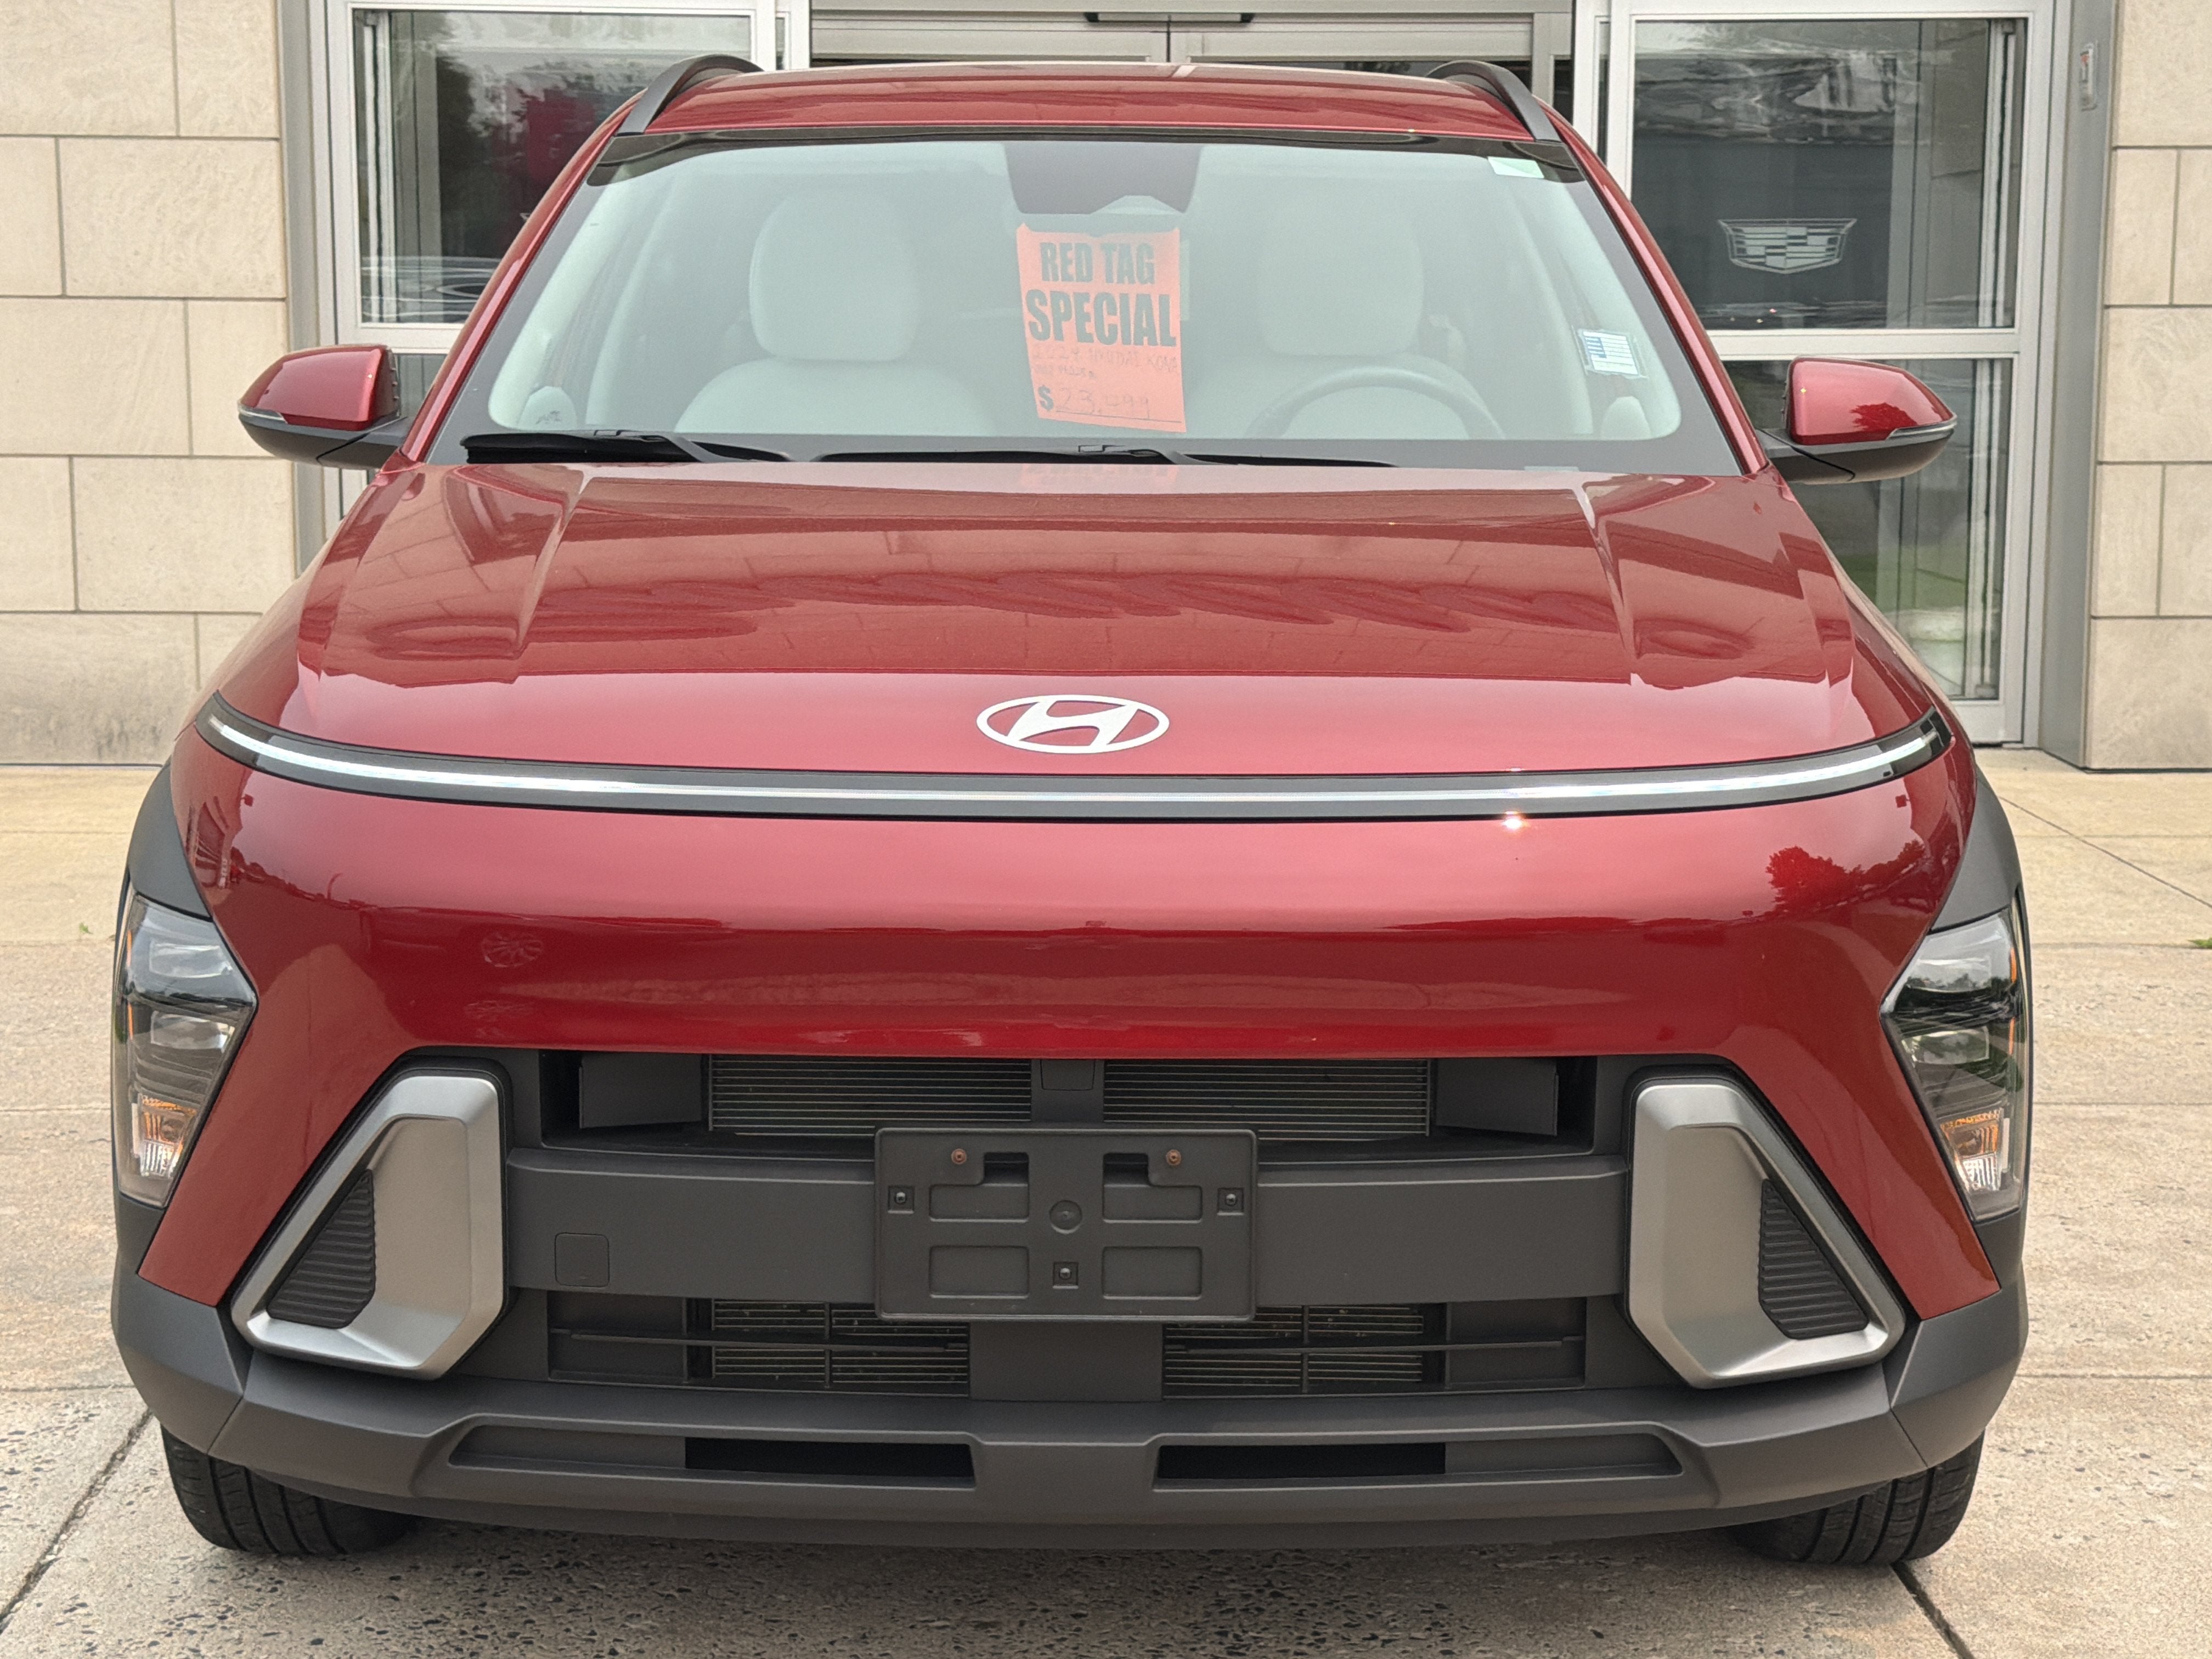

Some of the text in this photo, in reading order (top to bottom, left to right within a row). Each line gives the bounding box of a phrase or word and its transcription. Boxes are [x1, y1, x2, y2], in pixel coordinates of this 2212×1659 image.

[1040, 242, 1155, 284] RED TAG
[1026, 289, 1177, 347] SPECIAL
